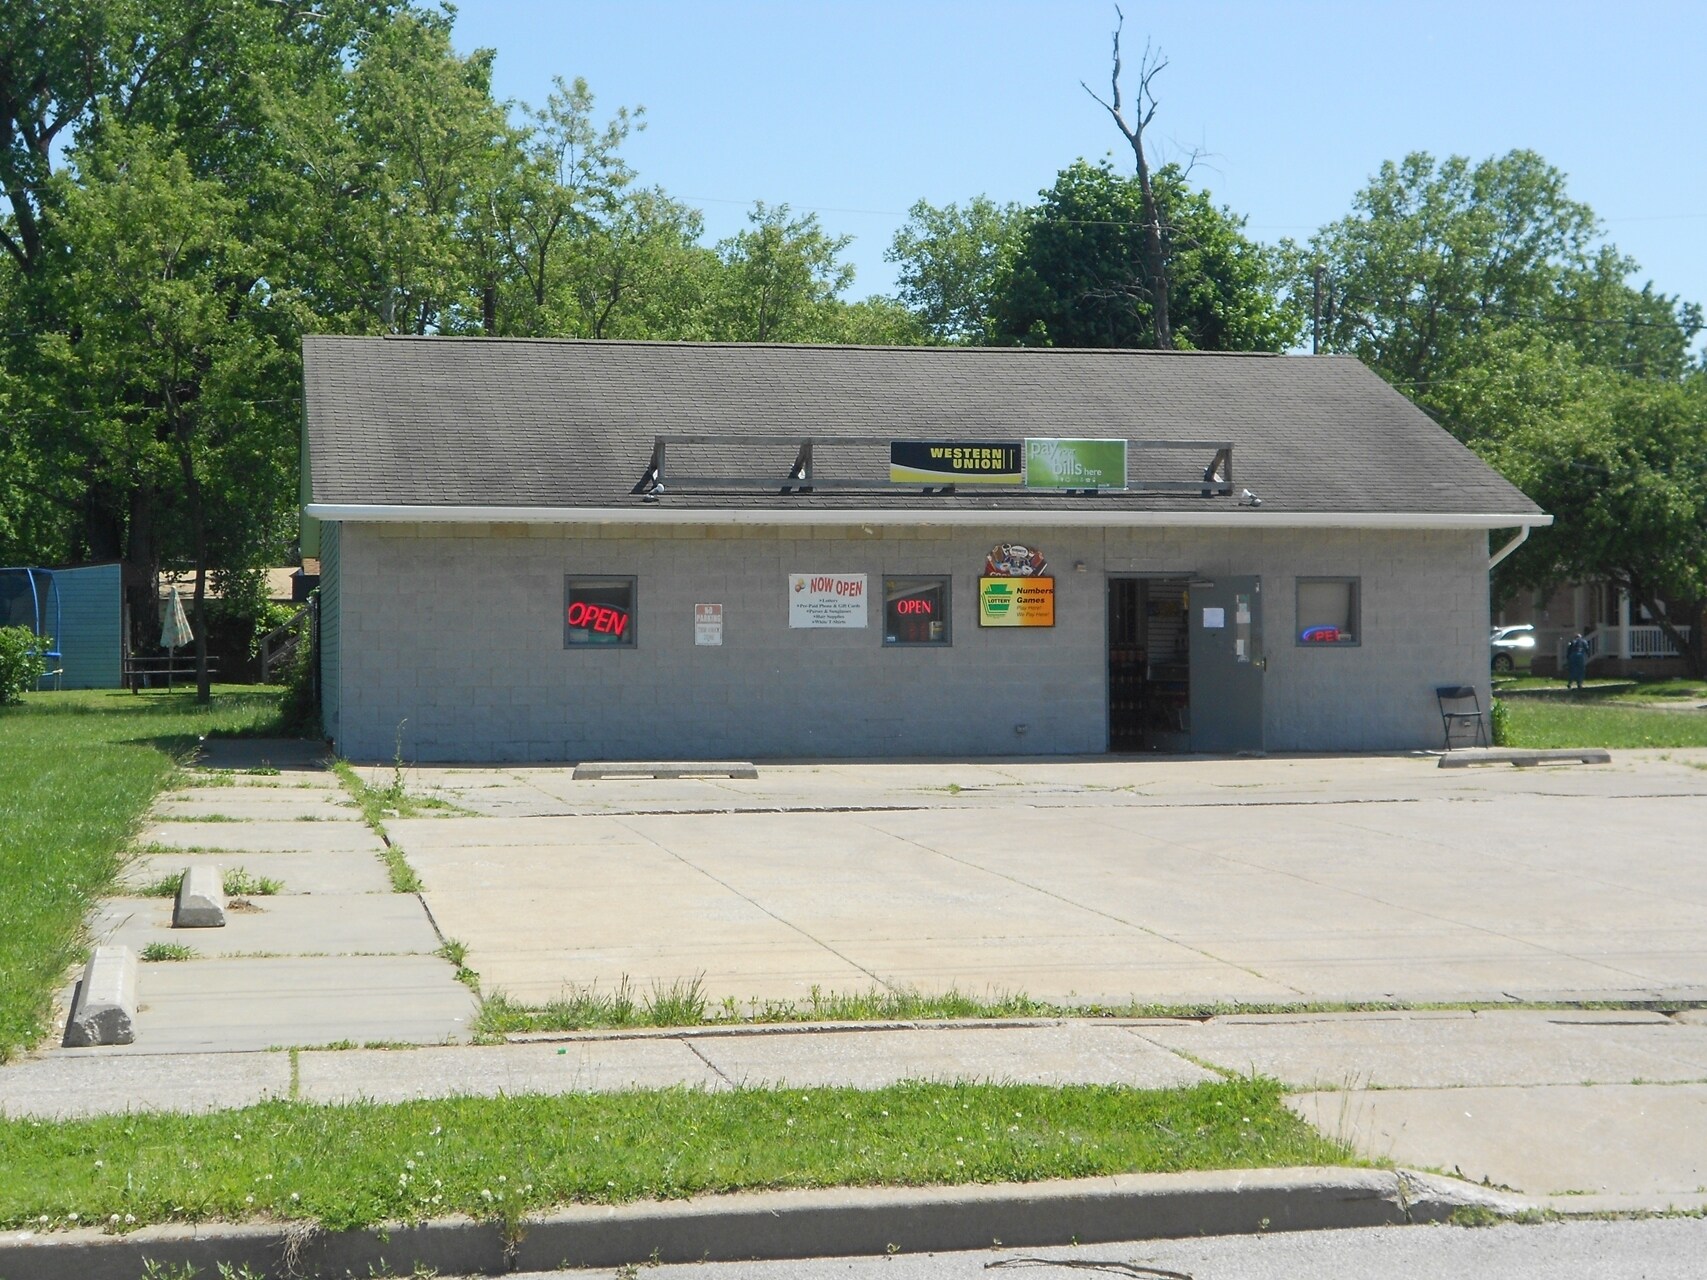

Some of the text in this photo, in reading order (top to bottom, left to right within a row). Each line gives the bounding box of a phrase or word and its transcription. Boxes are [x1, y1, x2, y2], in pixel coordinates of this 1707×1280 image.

[930, 447, 1002, 458] WESTERN
[1031, 441, 1058, 460] pay
[953, 459, 1002, 469] UNION
[1054, 457, 1102, 476] bills here
[810, 577, 863, 597] NOW OPEN
[897, 600, 931, 614] OPEN
[568, 602, 628, 635] OPEN
